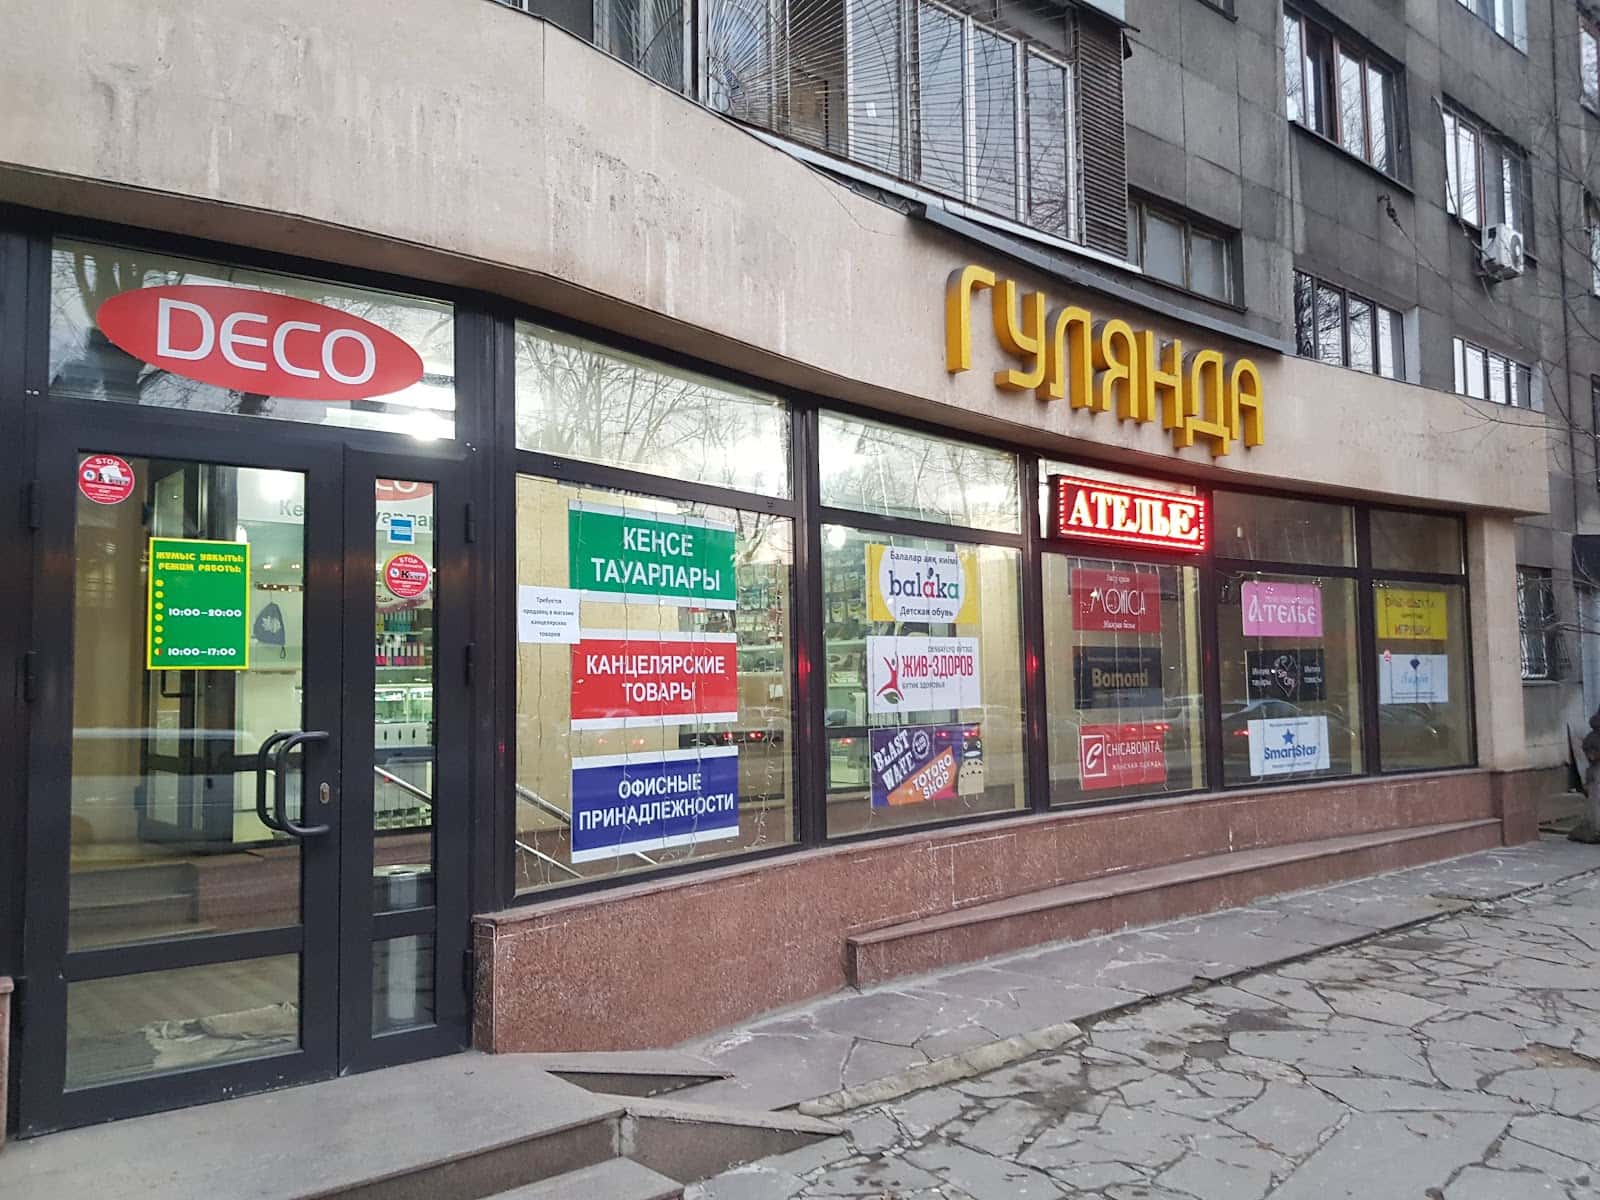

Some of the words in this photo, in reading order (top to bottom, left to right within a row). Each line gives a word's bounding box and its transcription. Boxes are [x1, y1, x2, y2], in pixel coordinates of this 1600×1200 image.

[156, 297, 377, 385] DECO
[945, 264, 1265, 458] ГУЛЯНДА
[1068, 488, 1200, 541] АТЕЛЬЕ
[622, 526, 694, 559] КЕҢСЕ
[591, 557, 721, 592] ТАУАРЛАРЫ
[888, 568, 959, 600] balaka
[900, 606, 930, 617] Детская
[585, 655, 726, 677] КАНЦЕЛЯРСКИЕ
[901, 655, 974, 679] ЖИВ-ЗДОРОВ
[1091, 667, 1149, 688] Bomond
[621, 682, 696, 702] ТОВАРЫ
[873, 729, 910, 773] BLAST
[1264, 744, 1317, 760] SmartStar
[618, 773, 702, 800] ОФИСНЫЕ
[882, 751, 916, 791] WAVE
[912, 754, 952, 792] TOTORO
[922, 771, 949, 800] SHOP
[578, 793, 735, 831] ПРИНАДЛЕЖНОСТИ
